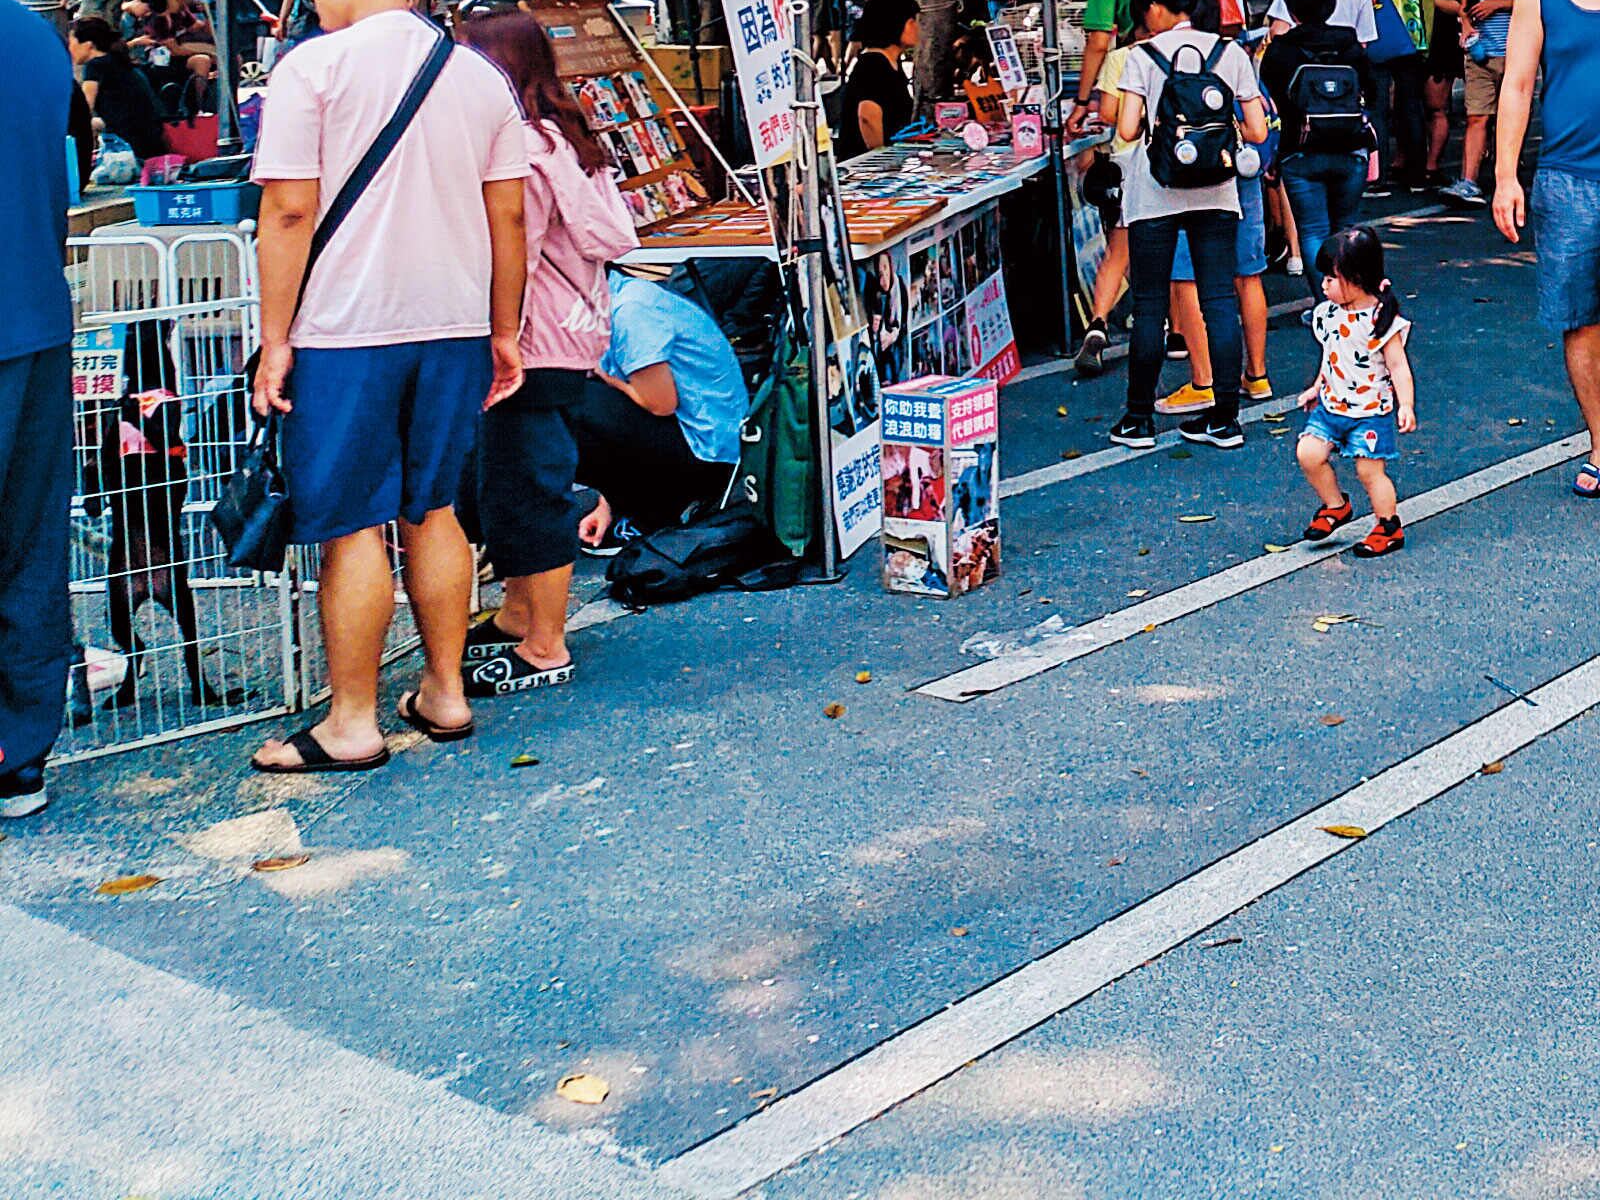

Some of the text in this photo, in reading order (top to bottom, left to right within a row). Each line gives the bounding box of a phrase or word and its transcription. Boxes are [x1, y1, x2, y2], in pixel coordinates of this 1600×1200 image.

[884, 398, 942, 420] 你助我養
[951, 390, 995, 420] 支持領養
[951, 410, 996, 441] 代替購買
